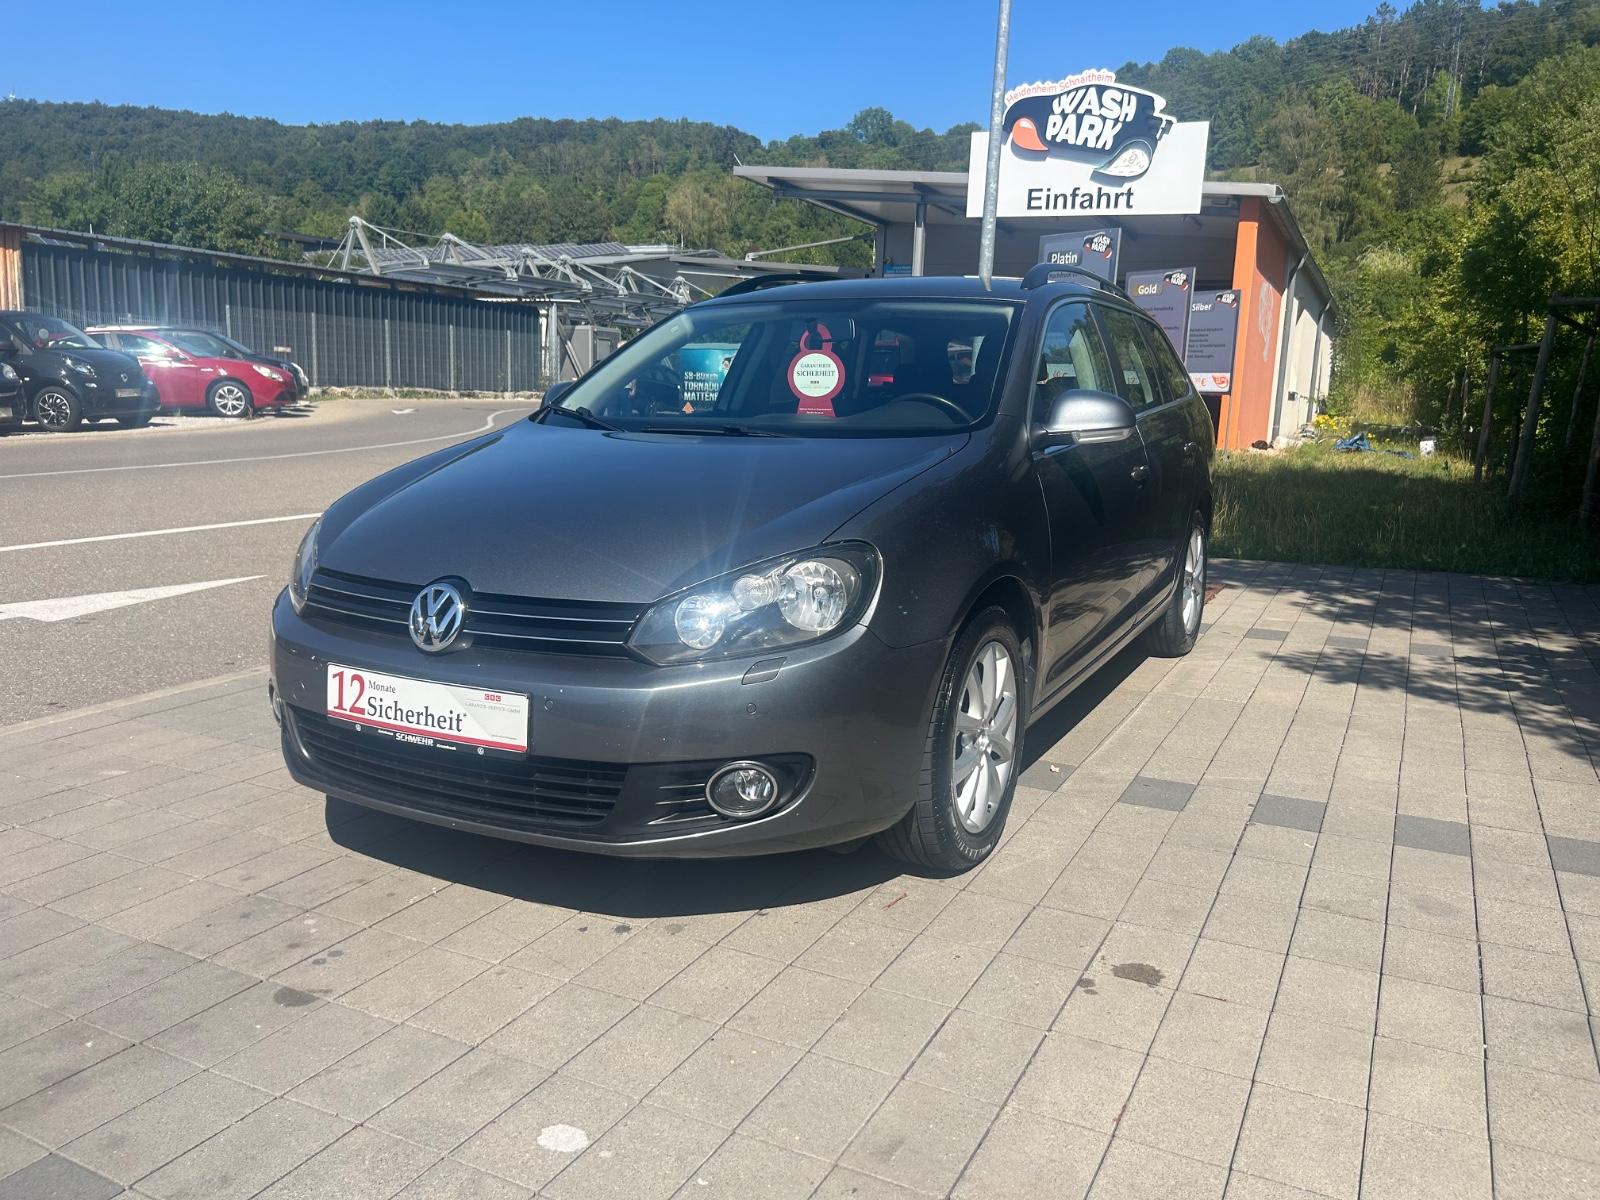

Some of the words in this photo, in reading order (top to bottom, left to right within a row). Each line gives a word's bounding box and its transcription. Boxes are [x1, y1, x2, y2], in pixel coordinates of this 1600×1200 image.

[1006, 84, 1057, 103] Heidenheim
[1059, 71, 1113, 91] Schnaitheim
[1052, 87, 1137, 123] WASH
[1045, 114, 1123, 150] PARK
[1027, 187, 1134, 211] Einfahrt
[1051, 251, 1078, 264] Platin
[1138, 284, 1157, 295] Gold
[1191, 303, 1212, 312] Silber
[332, 670, 366, 716] 12
[368, 679, 397, 694] Monate
[395, 732, 434, 747] SCHWEHR
